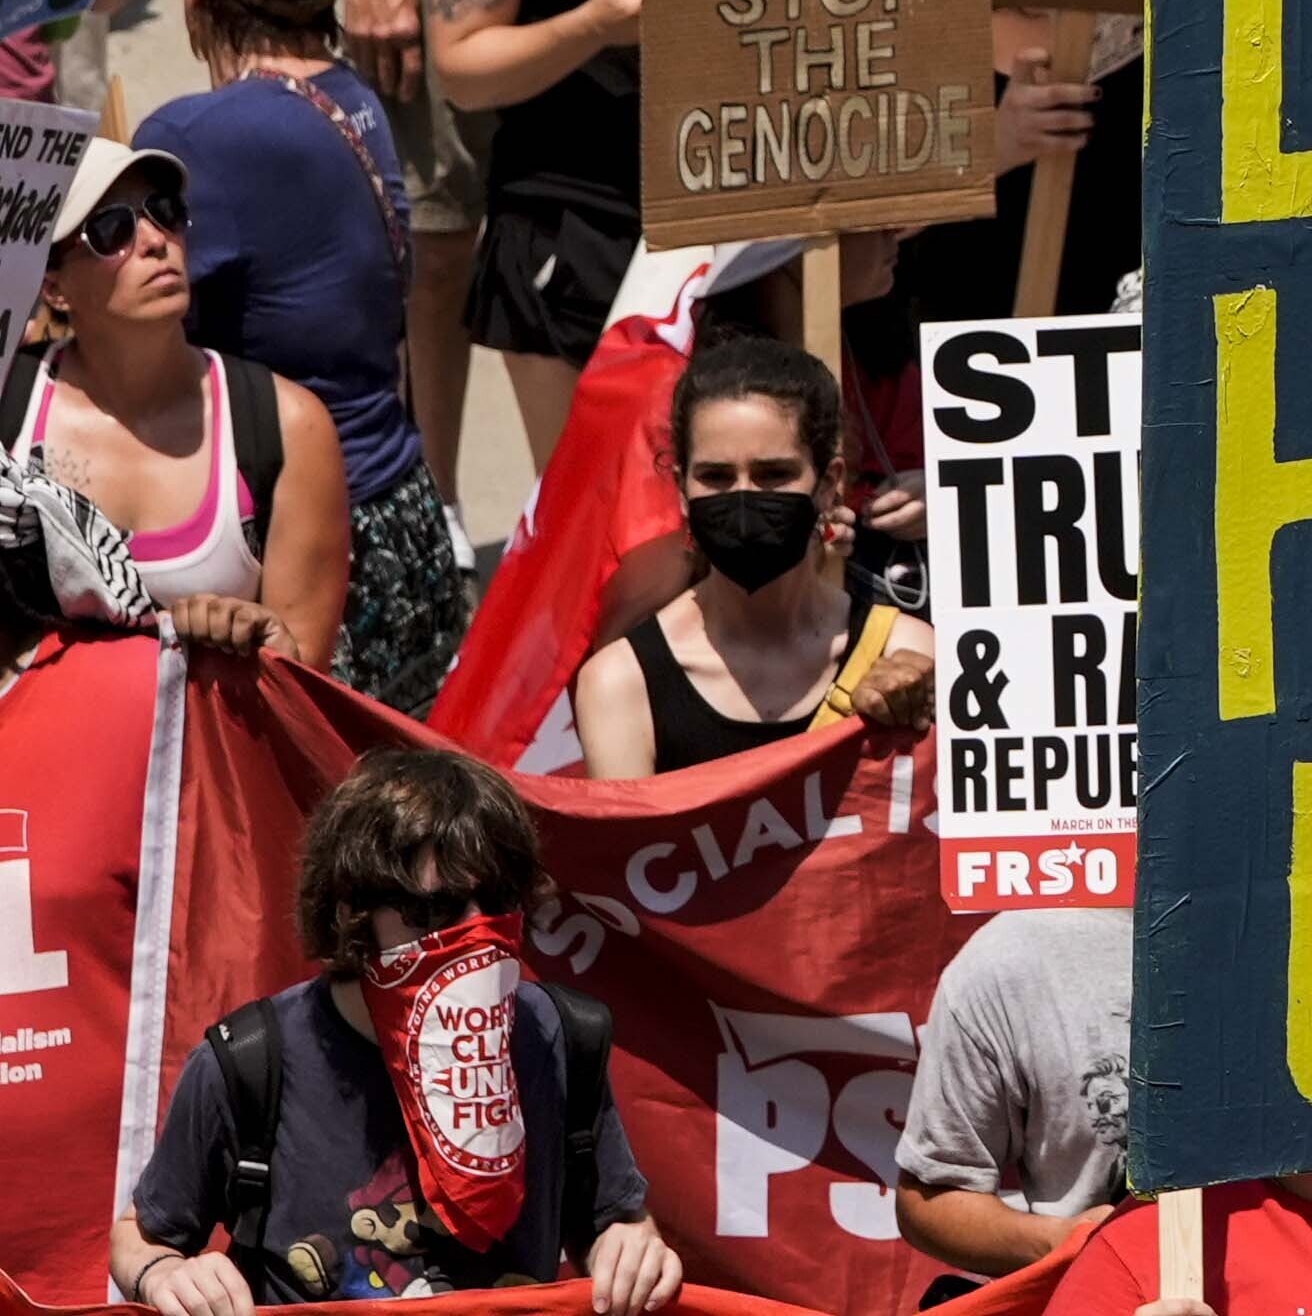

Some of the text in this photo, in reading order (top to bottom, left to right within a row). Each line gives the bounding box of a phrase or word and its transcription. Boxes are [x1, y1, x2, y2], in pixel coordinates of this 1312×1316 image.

[739, 19, 898, 95] THE
[36, 129, 88, 168] THE
[676, 83, 972, 193] GENOCIDE
[948, 628, 1011, 732] &
[1049, 816, 1094, 833] MARCH
[1096, 816, 1115, 831] ON
